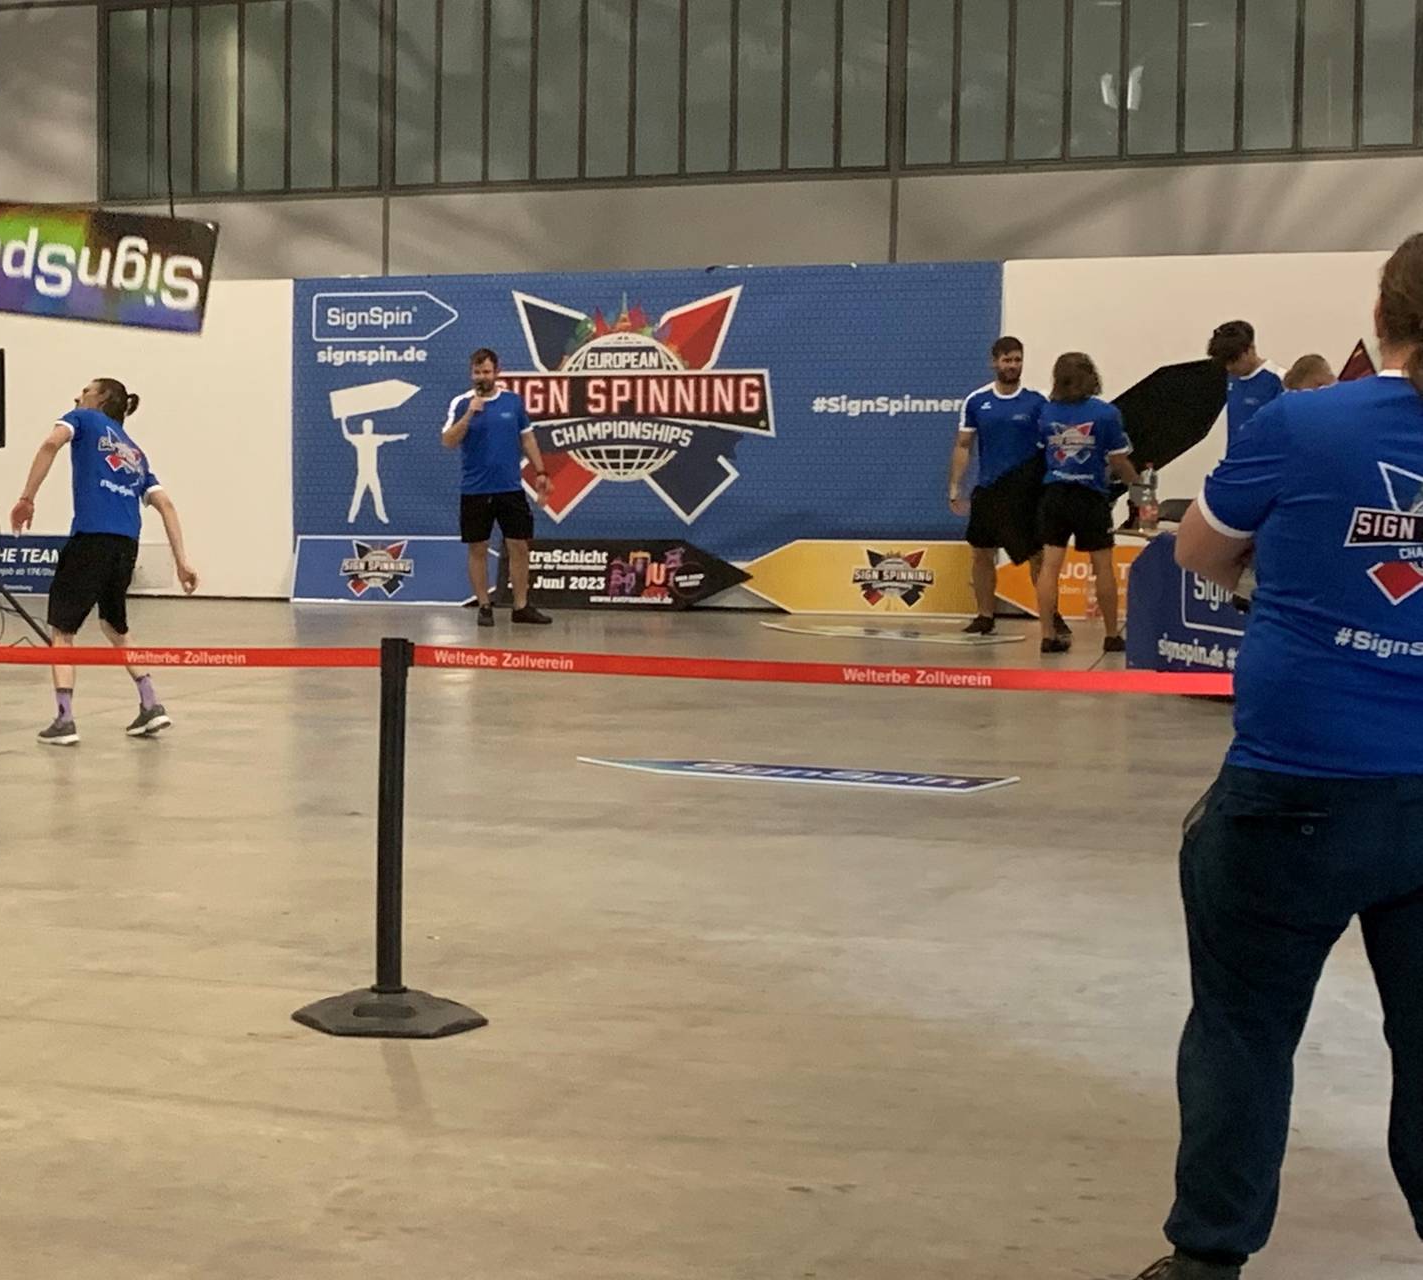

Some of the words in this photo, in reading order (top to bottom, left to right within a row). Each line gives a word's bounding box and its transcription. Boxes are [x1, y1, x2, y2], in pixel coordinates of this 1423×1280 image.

[327, 306, 412, 331] SignSpin
[317, 345, 426, 366] signspin.de
[587, 352, 659, 369] EUROPEAN
[587, 378, 760, 414] SPINNING
[551, 421, 693, 447] CHAMPIONSHIPS
[1356, 513, 1415, 540] SIGN
[529, 549, 608, 563] traSchicht
[533, 575, 565, 589] Juni
[569, 576, 606, 590] 2023
[854, 570, 878, 580] SIGN
[882, 570, 932, 580] SPINNING
[1158, 632, 1225, 668] signspin.de
[1334, 628, 1423, 657] #Signs
[126, 651, 180, 663] Welterbe
[184, 651, 246, 664] Zollverein
[434, 650, 497, 666] Welterbe
[502, 653, 574, 670] Zollverein
[843, 668, 910, 684] Welterbe
[915, 670, 992, 686] Zollverein
